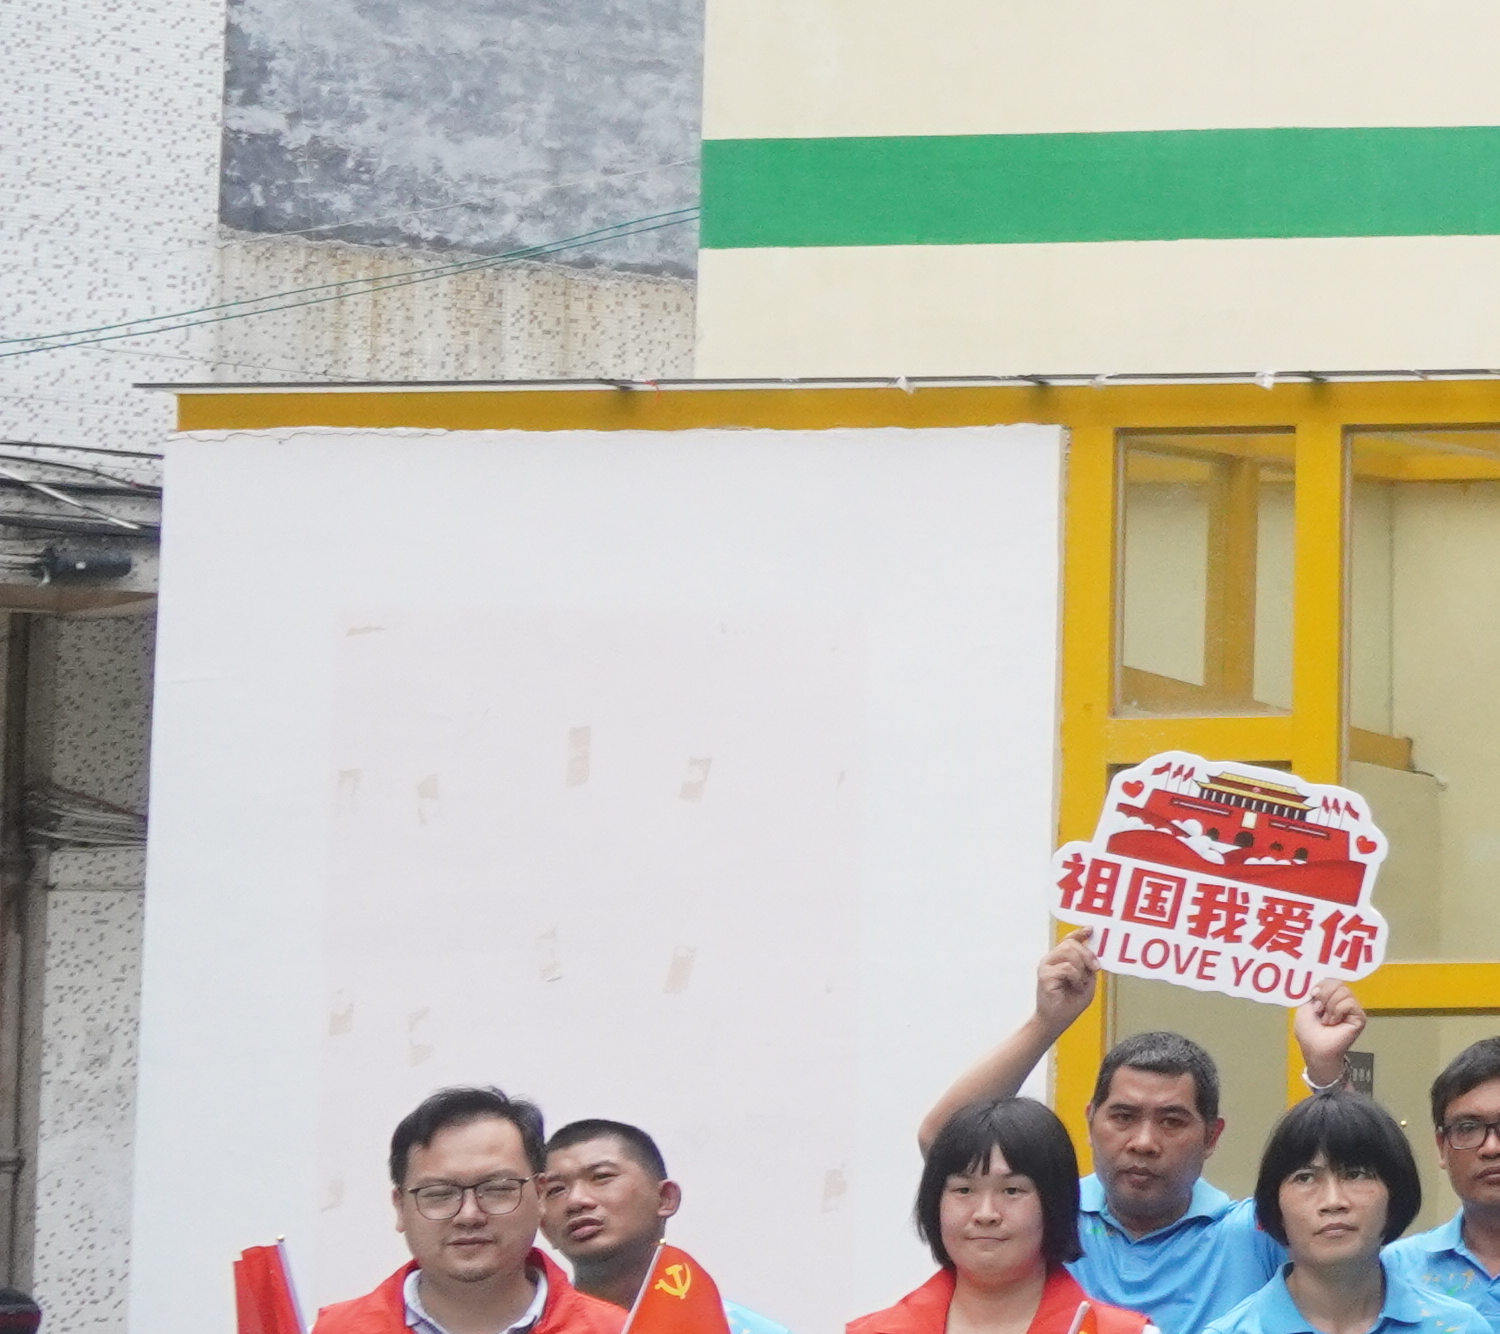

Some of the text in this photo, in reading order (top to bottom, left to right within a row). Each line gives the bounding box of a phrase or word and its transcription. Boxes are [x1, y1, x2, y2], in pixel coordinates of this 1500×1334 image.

[1056, 852, 1379, 973] 祖国我爱你
[1097, 927, 1314, 1001] I LOVE YOU
